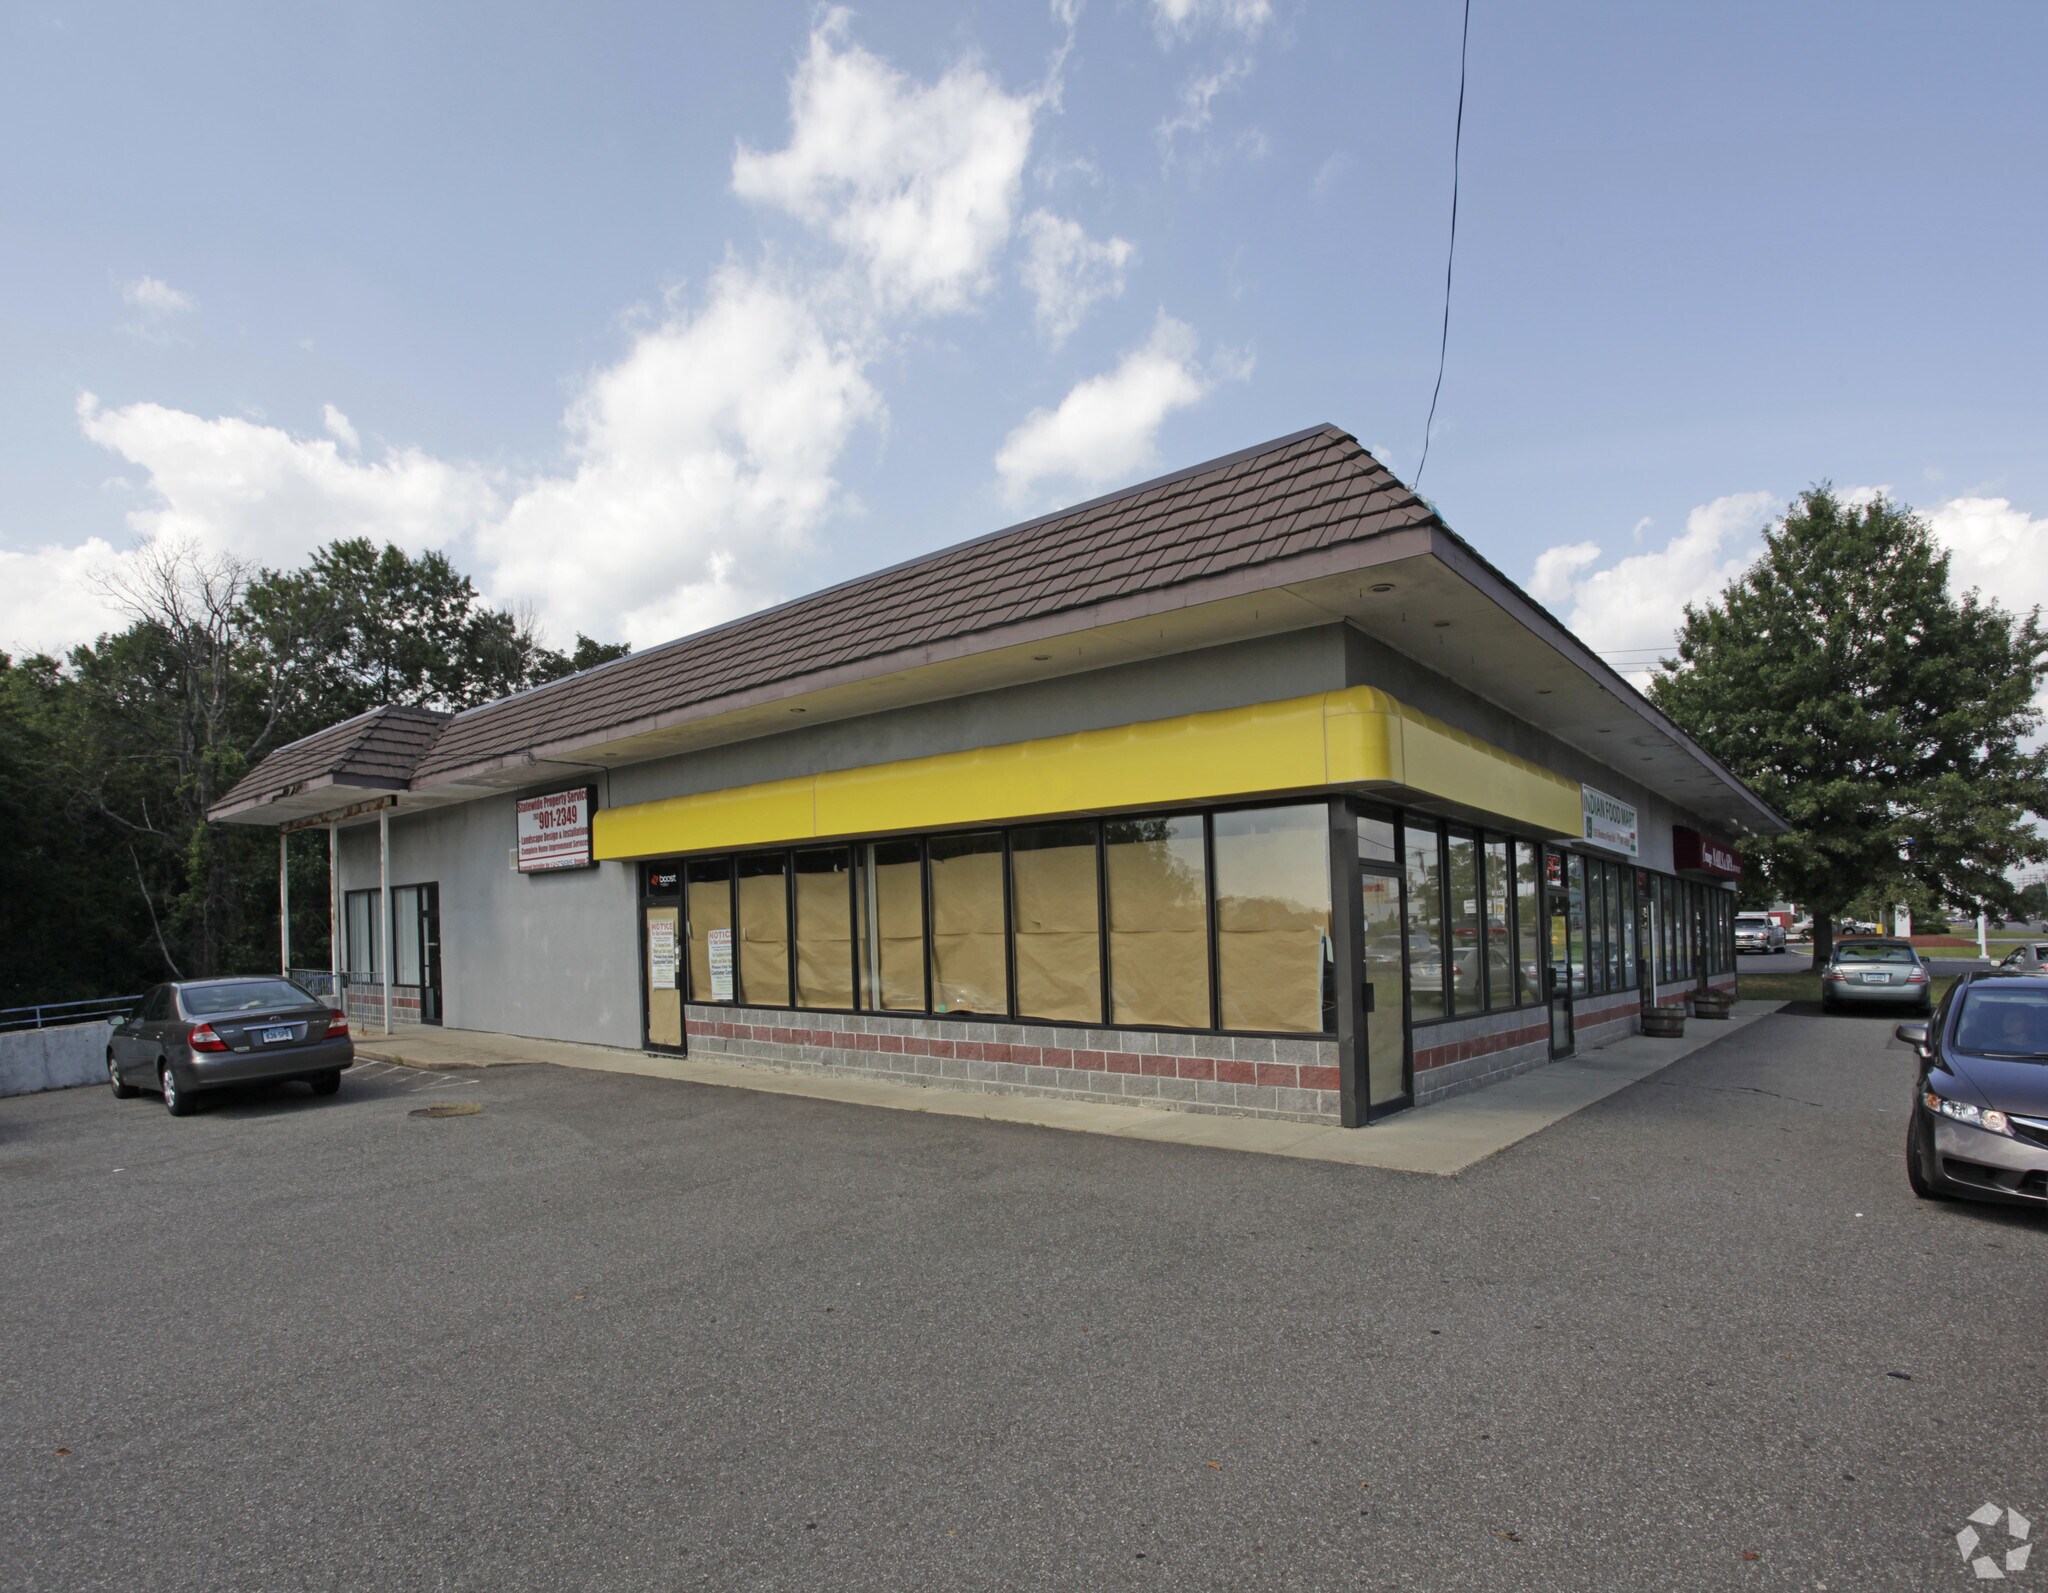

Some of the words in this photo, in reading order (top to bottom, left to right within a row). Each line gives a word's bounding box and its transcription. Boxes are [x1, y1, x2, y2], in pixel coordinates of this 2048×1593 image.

[518, 798, 543, 813] Statewide
[544, 794, 566, 809] Property
[1584, 792, 1605, 818] INDIAN
[1605, 800, 1620, 824] FOOD
[1621, 808, 1635, 828] MART
[539, 805, 577, 830] 901-2349
[521, 834, 543, 845] Landscape
[544, 831, 558, 841] Design
[659, 874, 676, 882] boost
[651, 922, 673, 930] NOTICE
